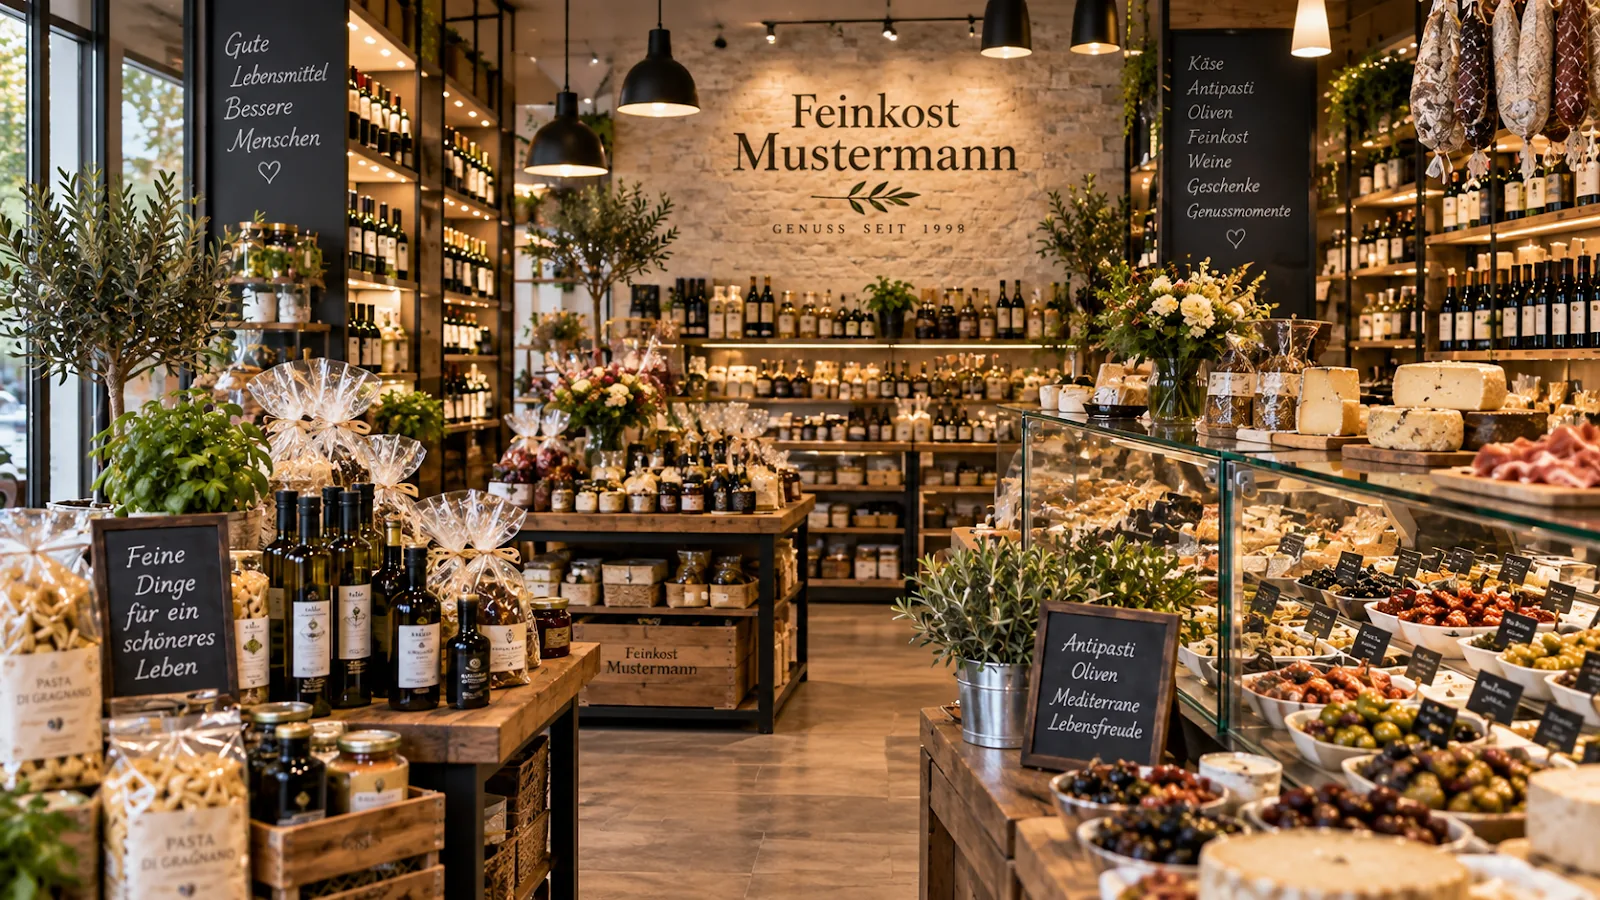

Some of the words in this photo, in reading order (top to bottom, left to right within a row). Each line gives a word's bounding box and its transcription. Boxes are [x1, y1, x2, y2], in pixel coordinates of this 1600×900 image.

[225, 31, 270, 59] Gute
[1188, 55, 1223, 70] Käse
[230, 62, 329, 88] Lebensmittel
[1187, 80, 1254, 98] Antipasti
[224, 96, 292, 120] Bessere
[792, 93, 960, 128] Feinkost
[1188, 105, 1232, 119] Oliven
[227, 127, 320, 153] Menschen
[1188, 128, 1248, 144] Feinkost
[733, 133, 1018, 171] Mustermann
[1189, 153, 1231, 168] Weine
[1188, 177, 1260, 195] Geschenke
[1187, 203, 1291, 219] Genussmomente
[772, 224, 845, 235] GENUSS
[863, 223, 907, 234] SEIT
[923, 223, 965, 234] 1998
[126, 545, 186, 569] Feine
[135, 574, 196, 601] Dinge
[123, 602, 160, 631] für
[168, 603, 199, 620] ein
[123, 630, 216, 653] schöneres
[1062, 633, 1135, 659] Antipasti
[625, 646, 678, 660] Feinkost
[135, 657, 197, 680] Leben
[607, 661, 698, 676] Mustermann
[1072, 662, 1117, 682] Oliven
[37, 677, 71, 687] PASTA
[17, 695, 29, 704] DI
[1049, 688, 1140, 714] Mediterrane
[1048, 712, 1143, 740] Lebensfreude
[166, 833, 215, 848] PASTA
[142, 860, 156, 870] DI
